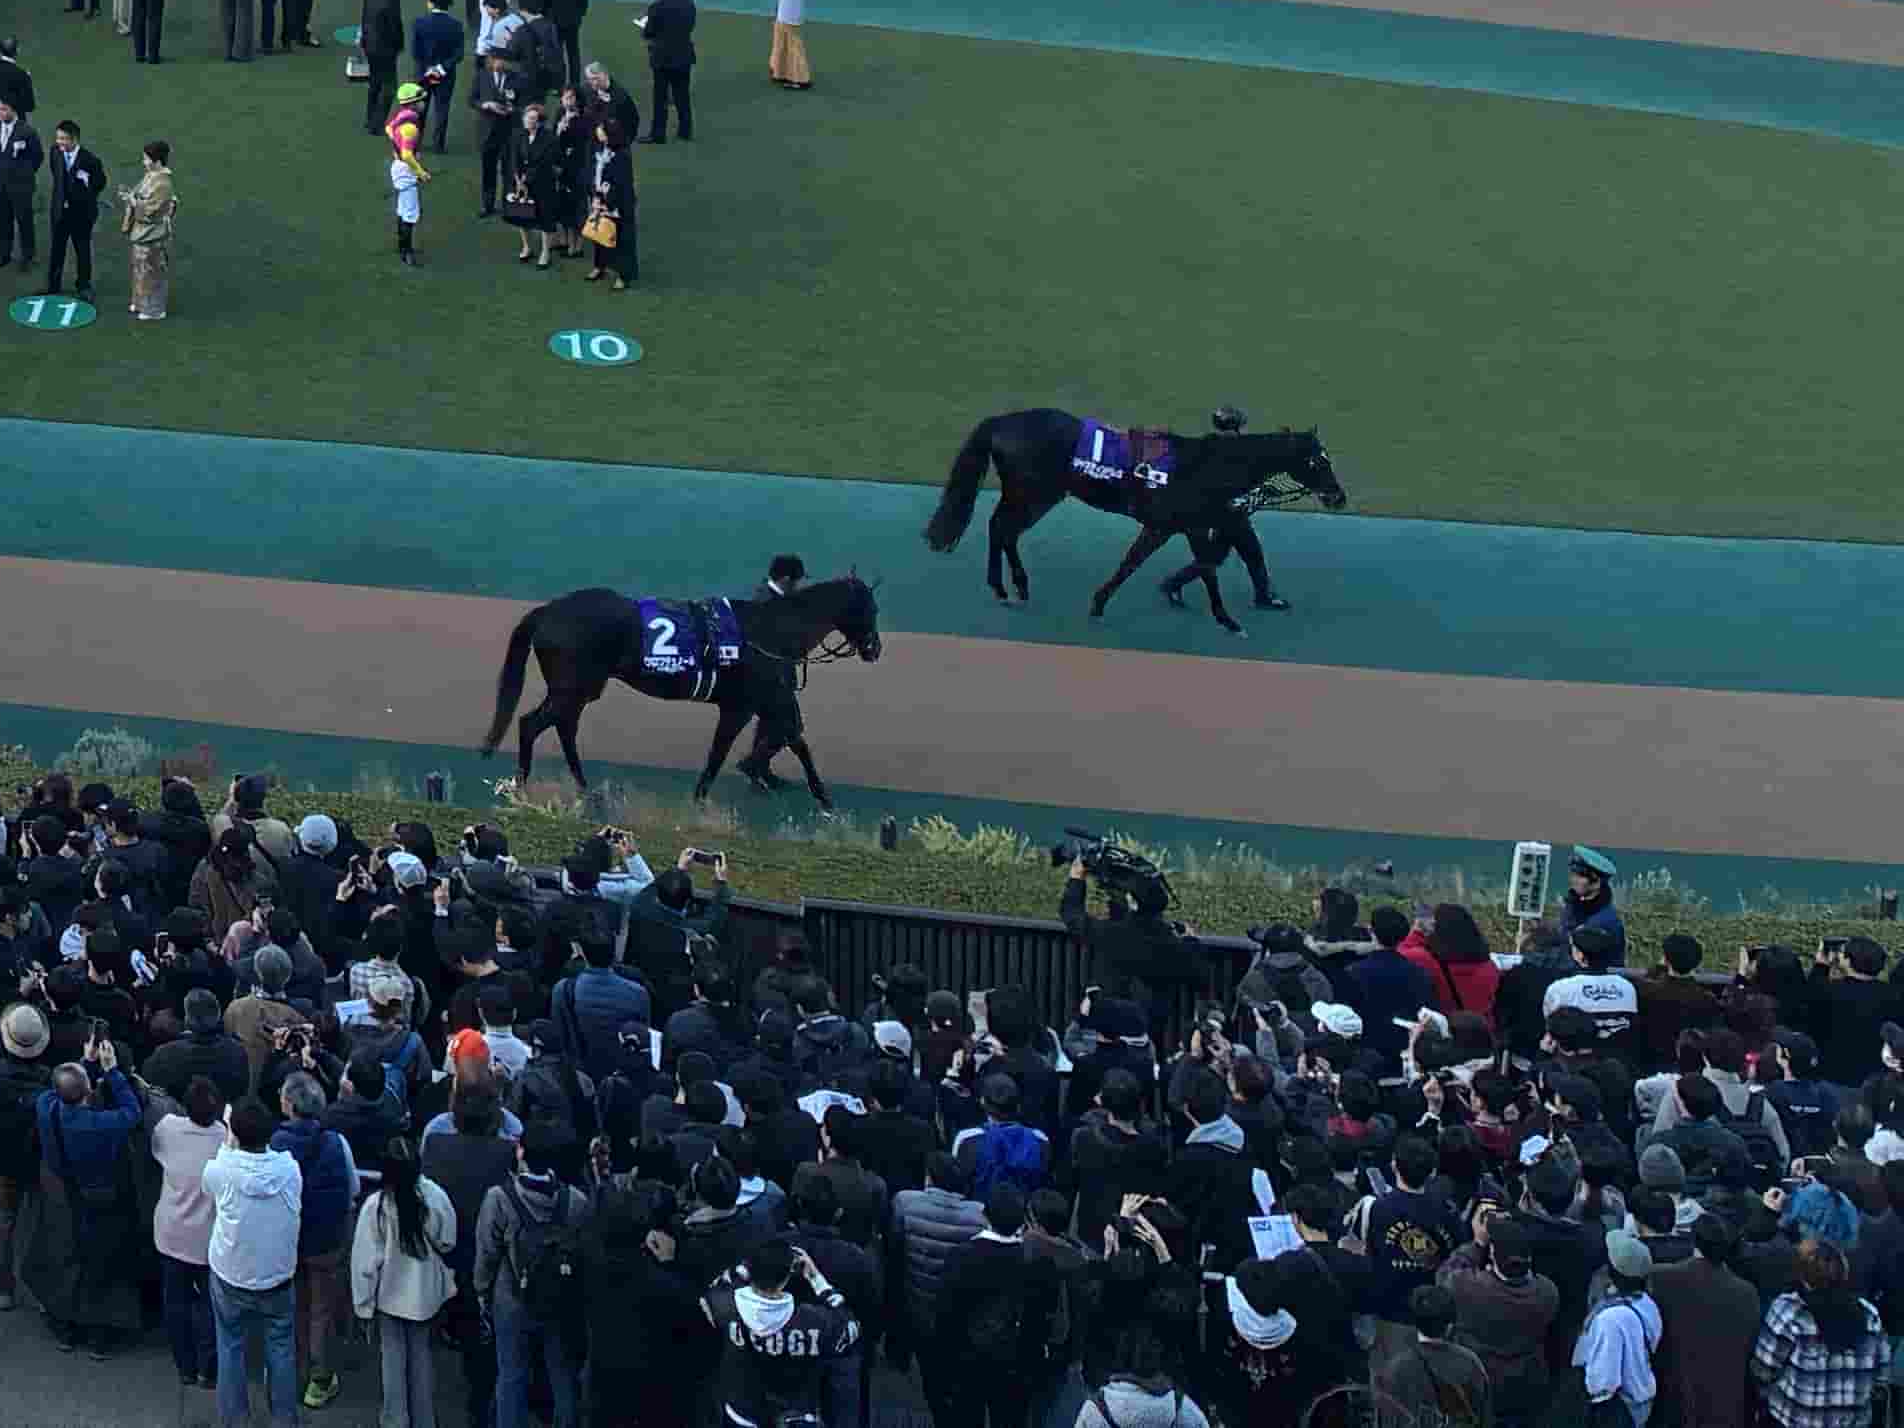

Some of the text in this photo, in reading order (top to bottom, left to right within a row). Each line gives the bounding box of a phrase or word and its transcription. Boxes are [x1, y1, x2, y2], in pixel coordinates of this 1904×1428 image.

[23, 297, 78, 326] 11
[561, 332, 629, 361] 10
[1092, 429, 1105, 463] 1
[648, 617, 679, 656] 2
